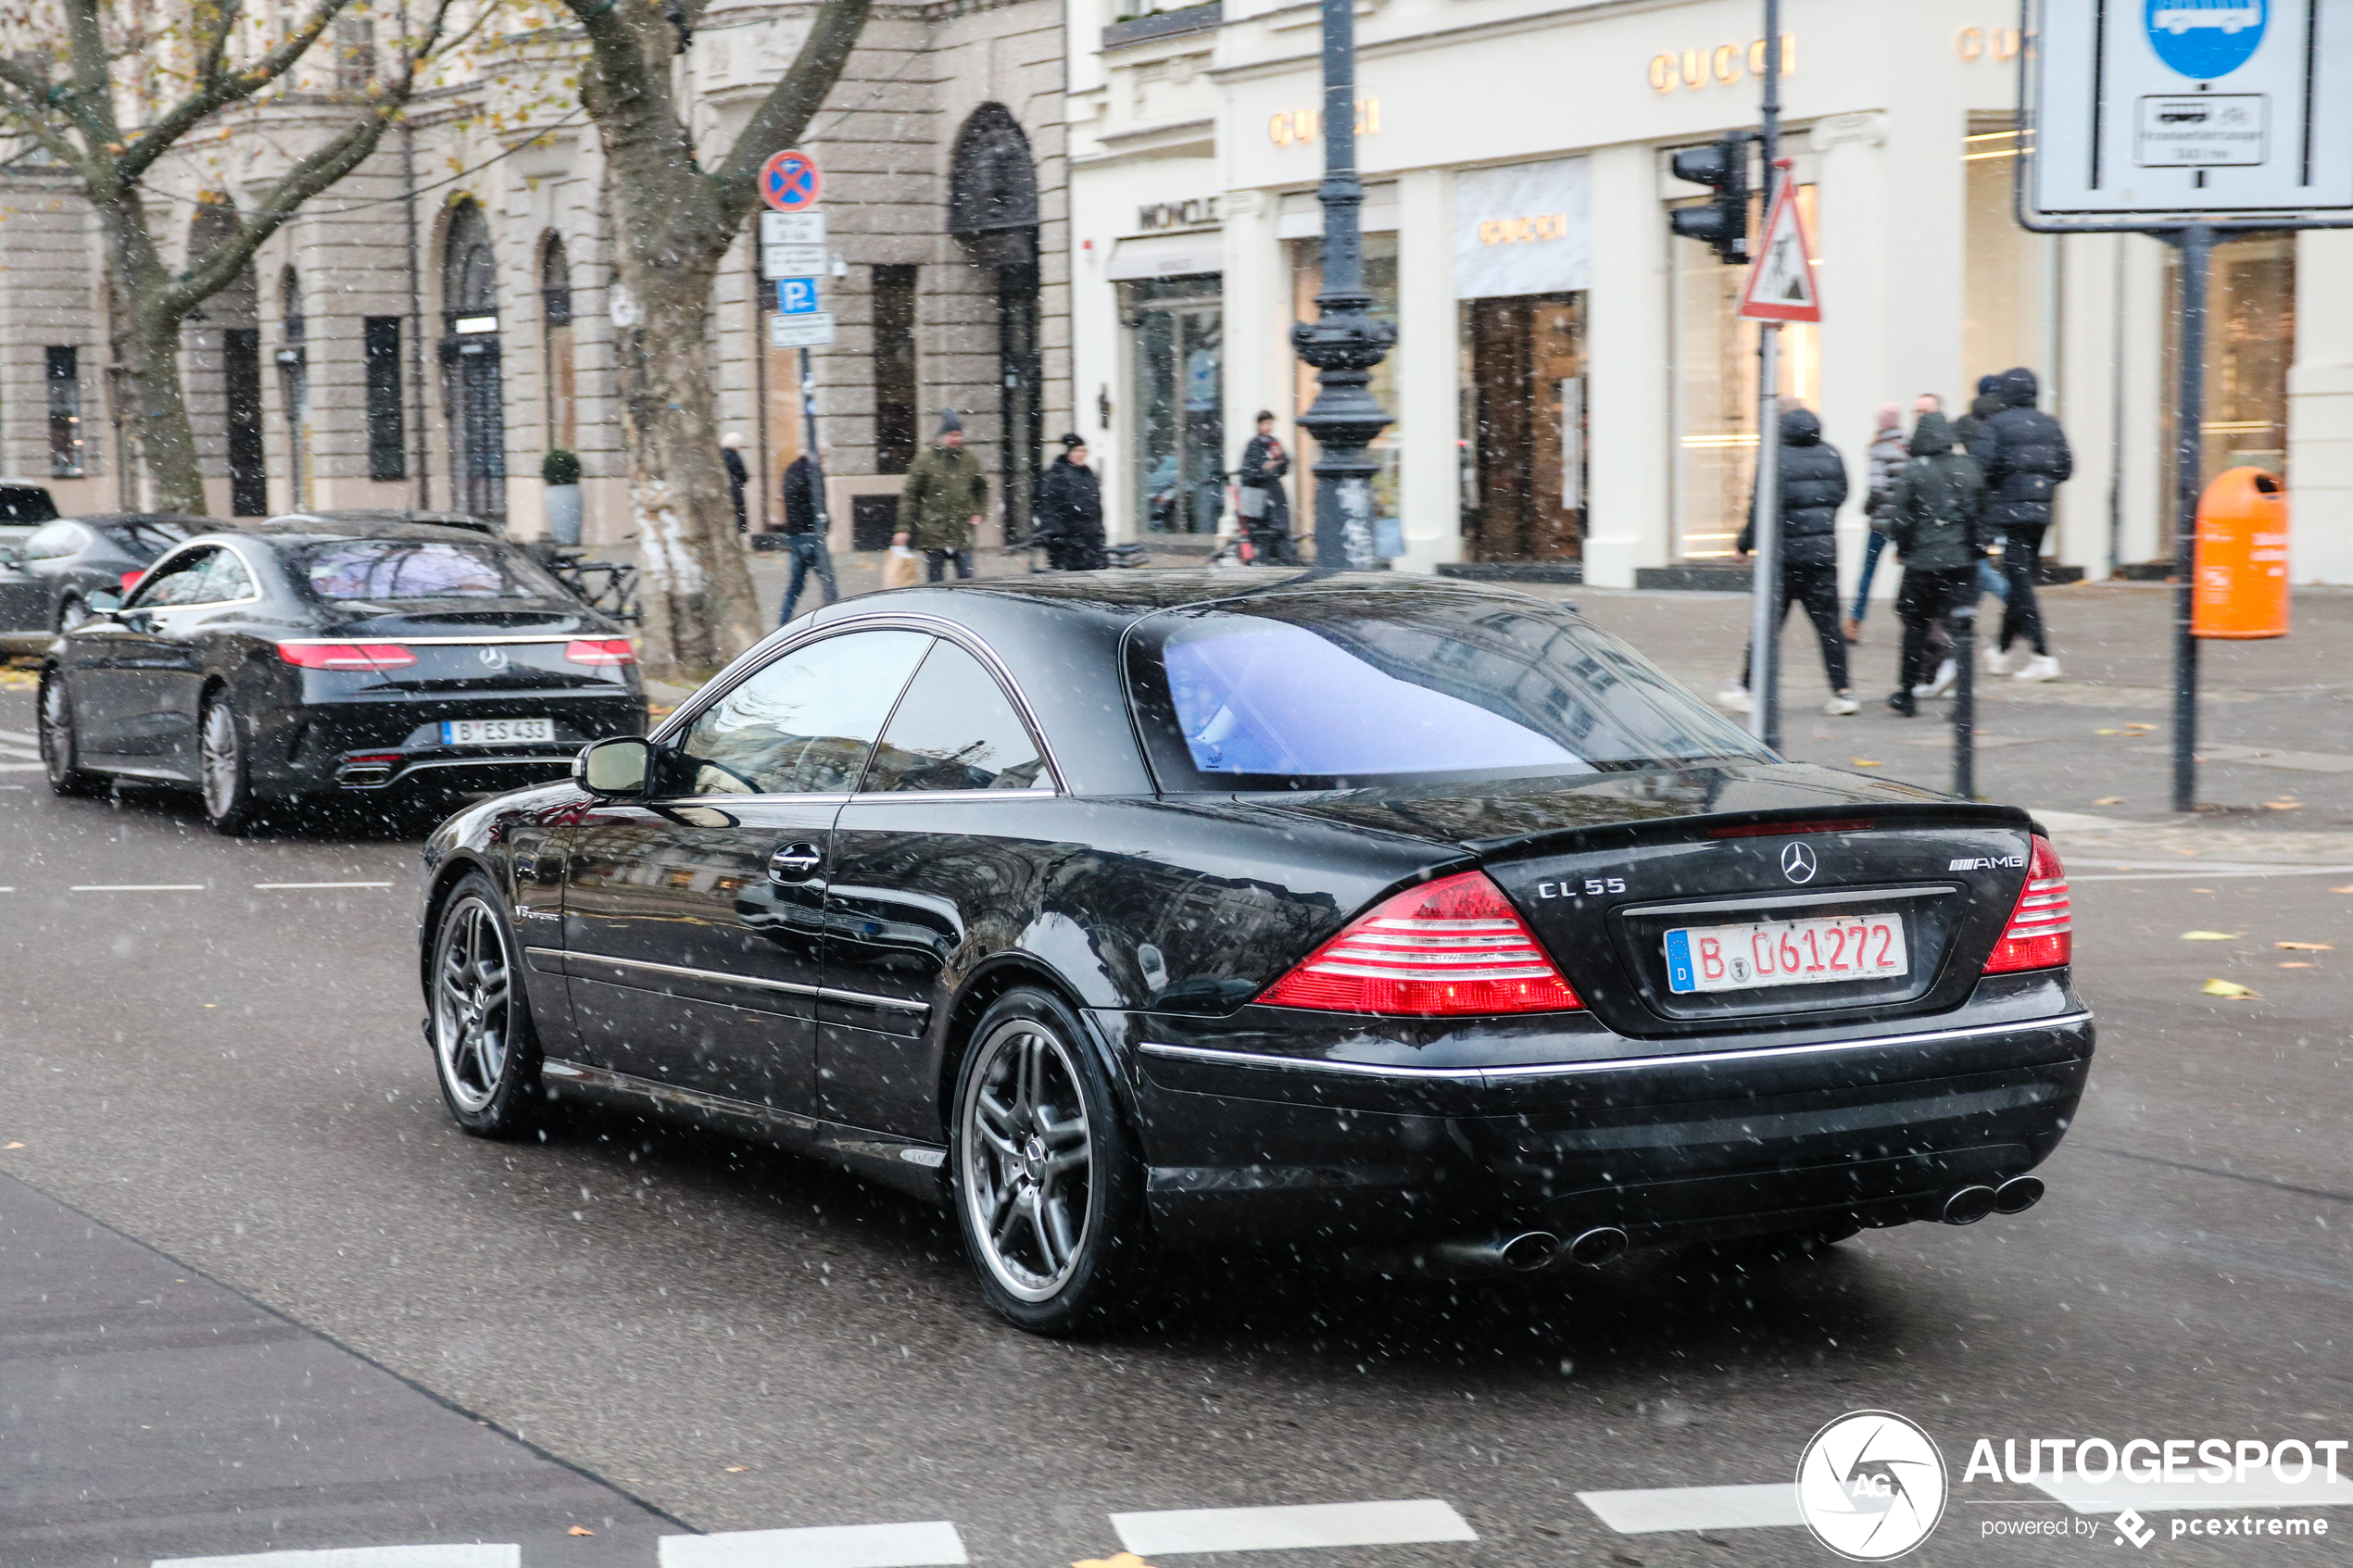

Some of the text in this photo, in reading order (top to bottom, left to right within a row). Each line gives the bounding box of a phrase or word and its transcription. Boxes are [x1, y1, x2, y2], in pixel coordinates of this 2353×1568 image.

[1479, 213, 1567, 245] GUCCI
[785, 282, 808, 311] P
[460, 721, 546, 740] B ES 433
[1973, 856, 2023, 870] AMG
[1538, 877, 1626, 899] CL 55
[1699, 936, 1725, 980] B
[1751, 924, 1895, 975] 061272
[1677, 967, 1687, 981] D
